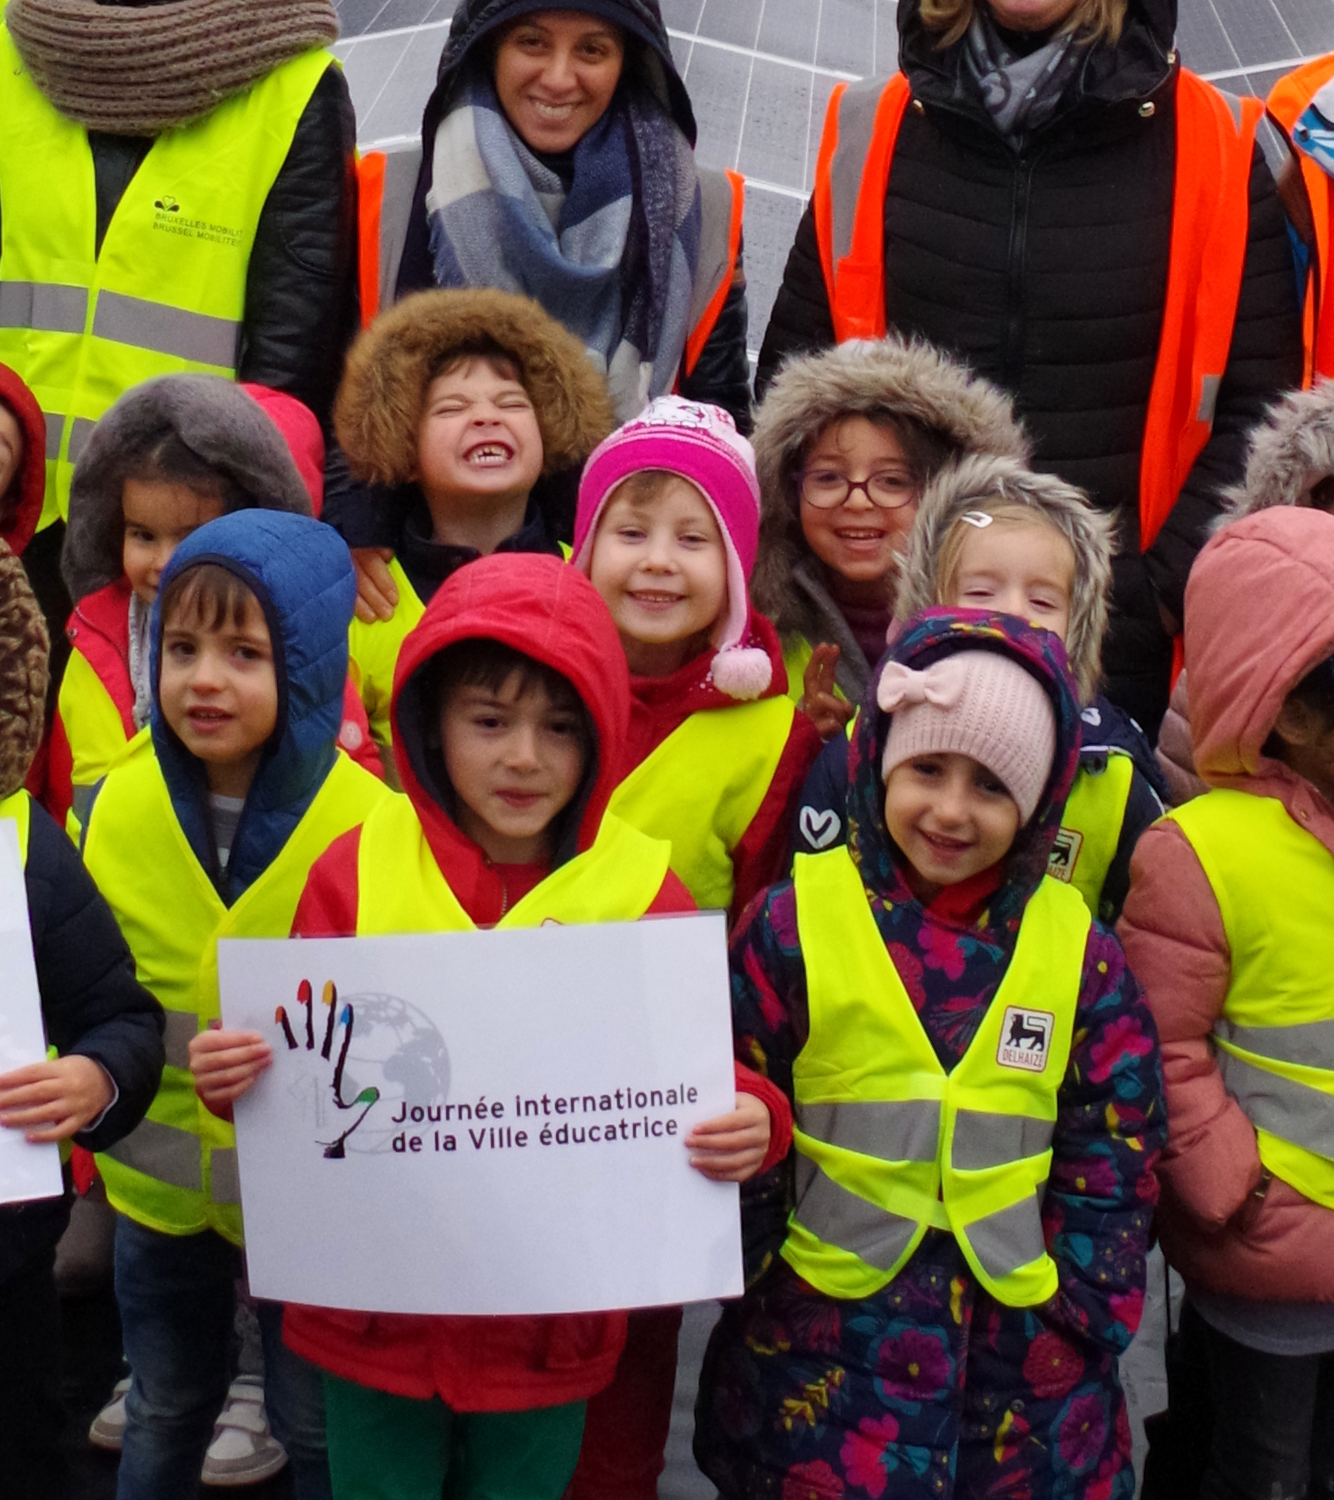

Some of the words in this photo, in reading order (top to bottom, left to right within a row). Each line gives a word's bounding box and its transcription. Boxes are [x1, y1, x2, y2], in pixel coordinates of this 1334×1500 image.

[153, 221, 193, 237] BRUSSEL
[155, 213, 207, 230] BRUXELLES
[1002, 1048, 1044, 1068] DELHAIZE
[391, 1096, 505, 1124] Journée
[515, 1083, 698, 1117] internationale
[391, 1131, 423, 1153] de
[433, 1130, 458, 1152] la
[467, 1126, 529, 1150] Ville
[538, 1116, 679, 1146] éducatrice
